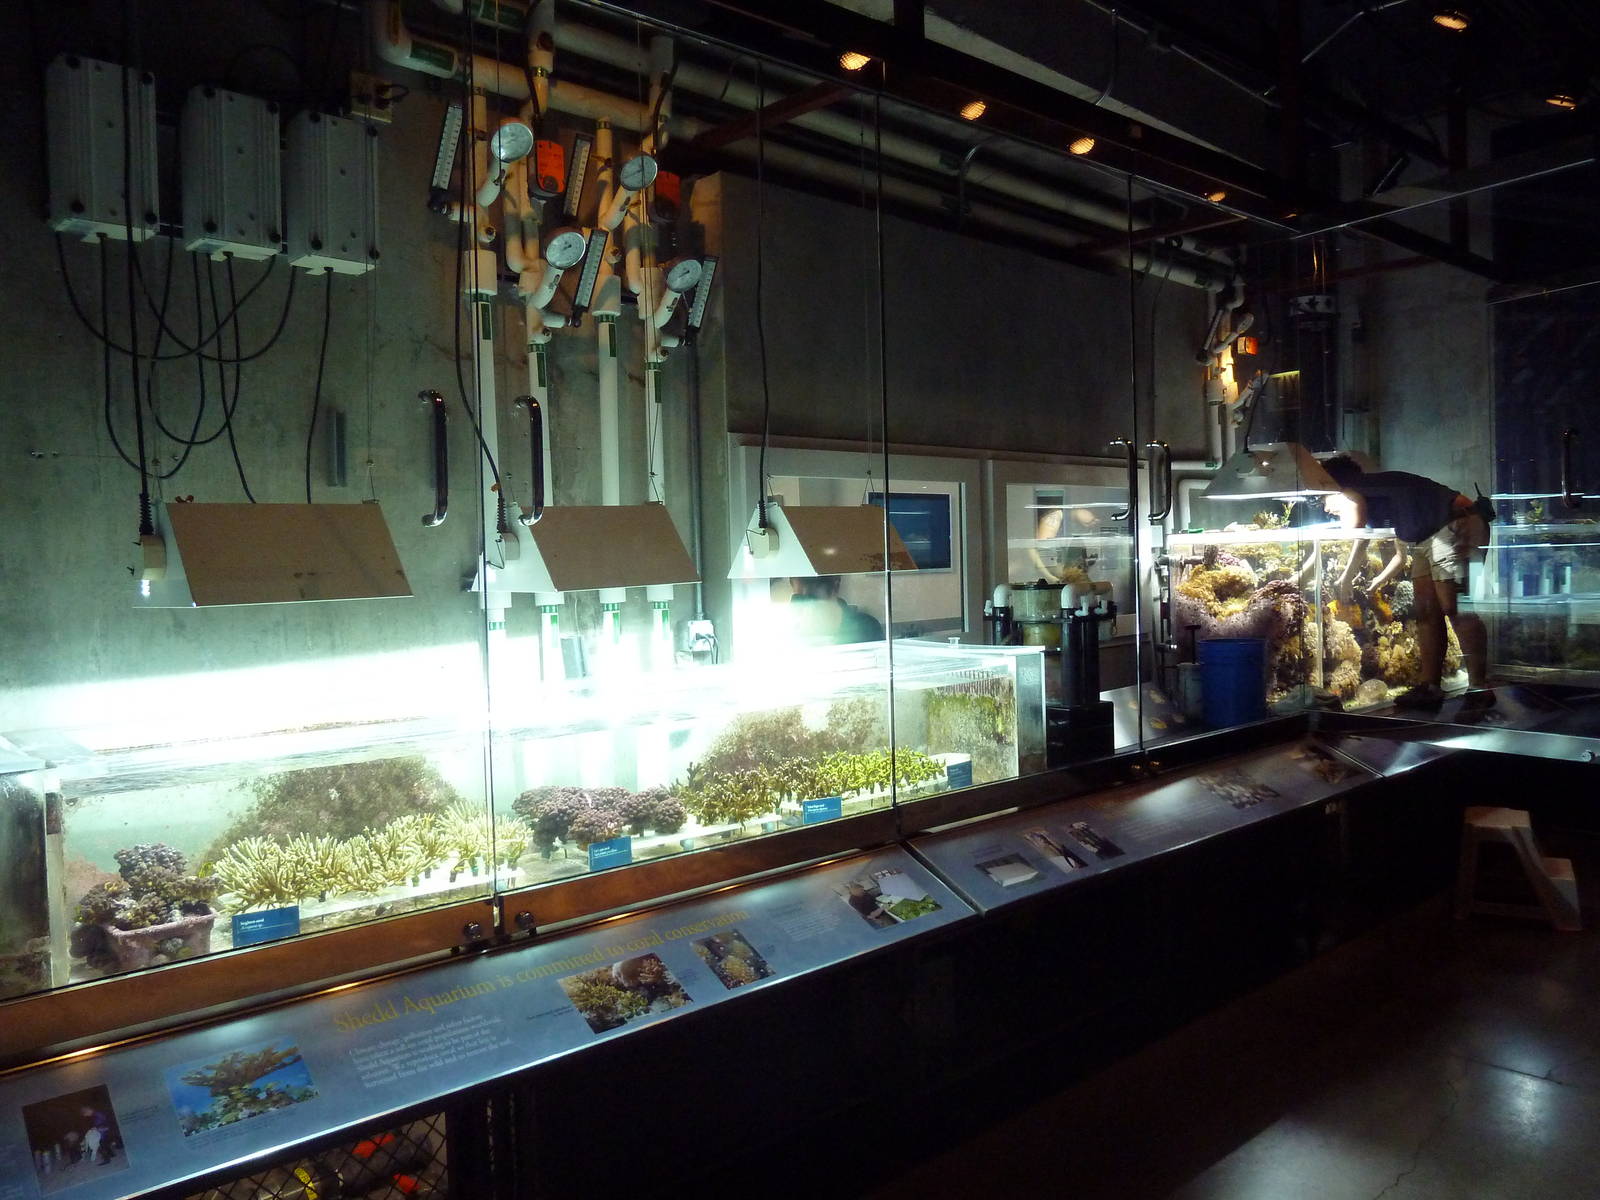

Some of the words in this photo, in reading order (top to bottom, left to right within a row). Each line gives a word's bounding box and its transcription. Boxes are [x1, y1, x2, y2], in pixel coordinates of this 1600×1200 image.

[334, 1001, 398, 1033] Shedd
[403, 981, 496, 1015] Aquarium
[499, 974, 514, 988] is
[516, 949, 603, 979] committed
[608, 943, 626, 958] to
[627, 931, 665, 952] coral
[665, 910, 748, 940] conservation
